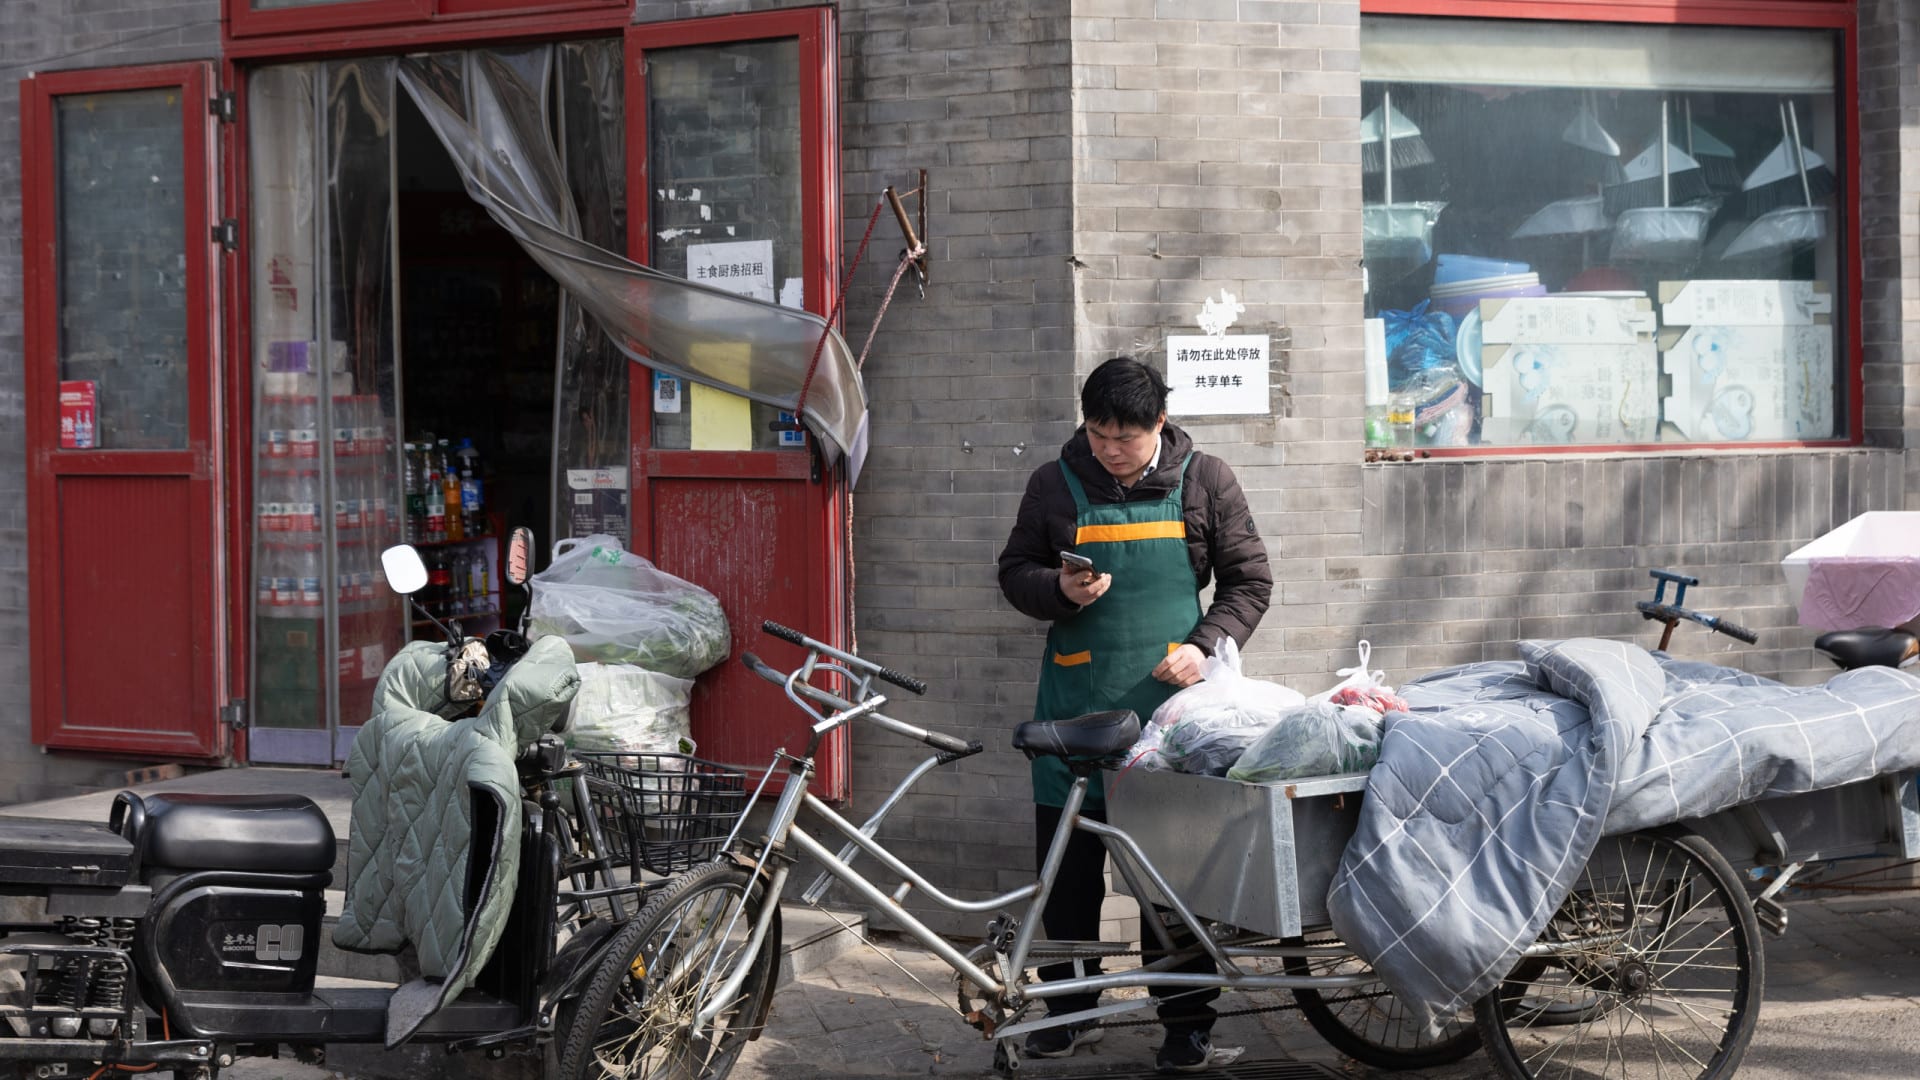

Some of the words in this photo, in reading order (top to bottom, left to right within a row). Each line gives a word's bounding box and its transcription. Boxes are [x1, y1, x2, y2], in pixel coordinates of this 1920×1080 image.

[697, 262, 763, 279] 主食厨房招租
[1177, 348, 1260, 362] 请勿在此处停放
[1195, 374, 1243, 388] 共享单车
